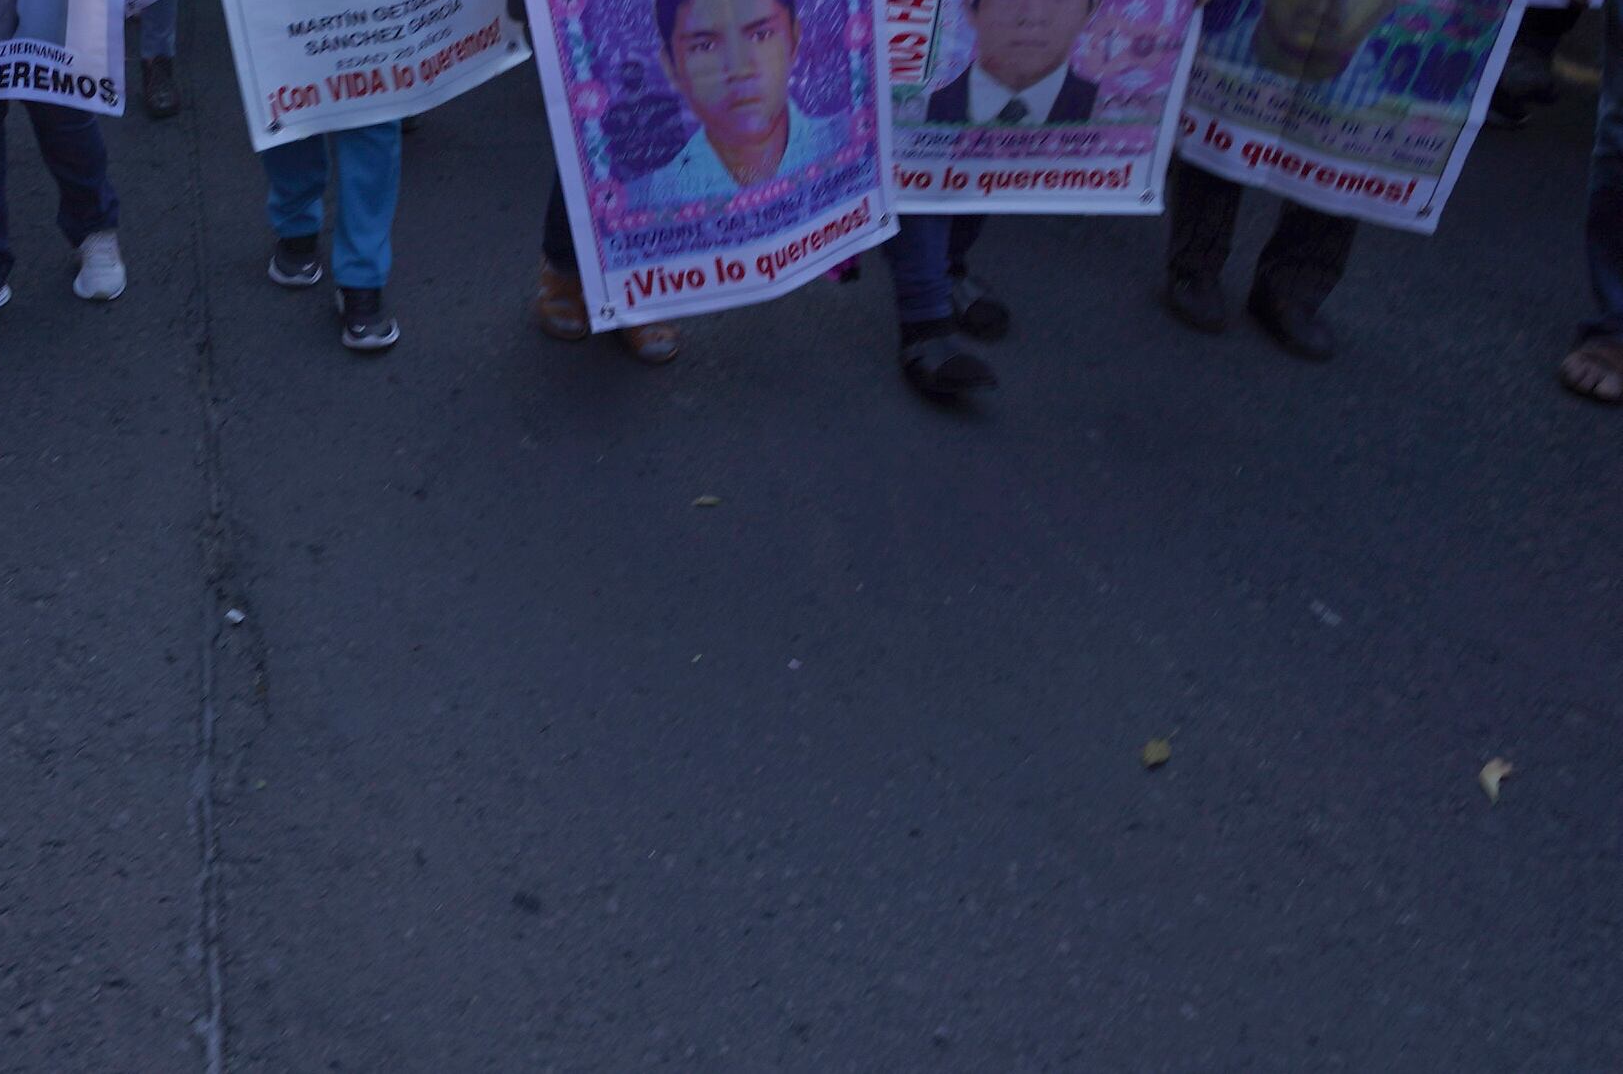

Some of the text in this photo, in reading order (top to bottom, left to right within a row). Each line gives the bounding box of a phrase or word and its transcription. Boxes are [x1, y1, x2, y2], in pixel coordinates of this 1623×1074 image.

[325, 64, 388, 103] VIDA
[392, 62, 414, 91] lo
[940, 165, 970, 192] lo
[976, 163, 1134, 197] queremos!
[1203, 117, 1235, 153] lo
[1240, 137, 1419, 207] queremos!
[624, 265, 706, 309] ¡Vivo
[715, 256, 747, 286] lo
[755, 195, 871, 282] queremos!
